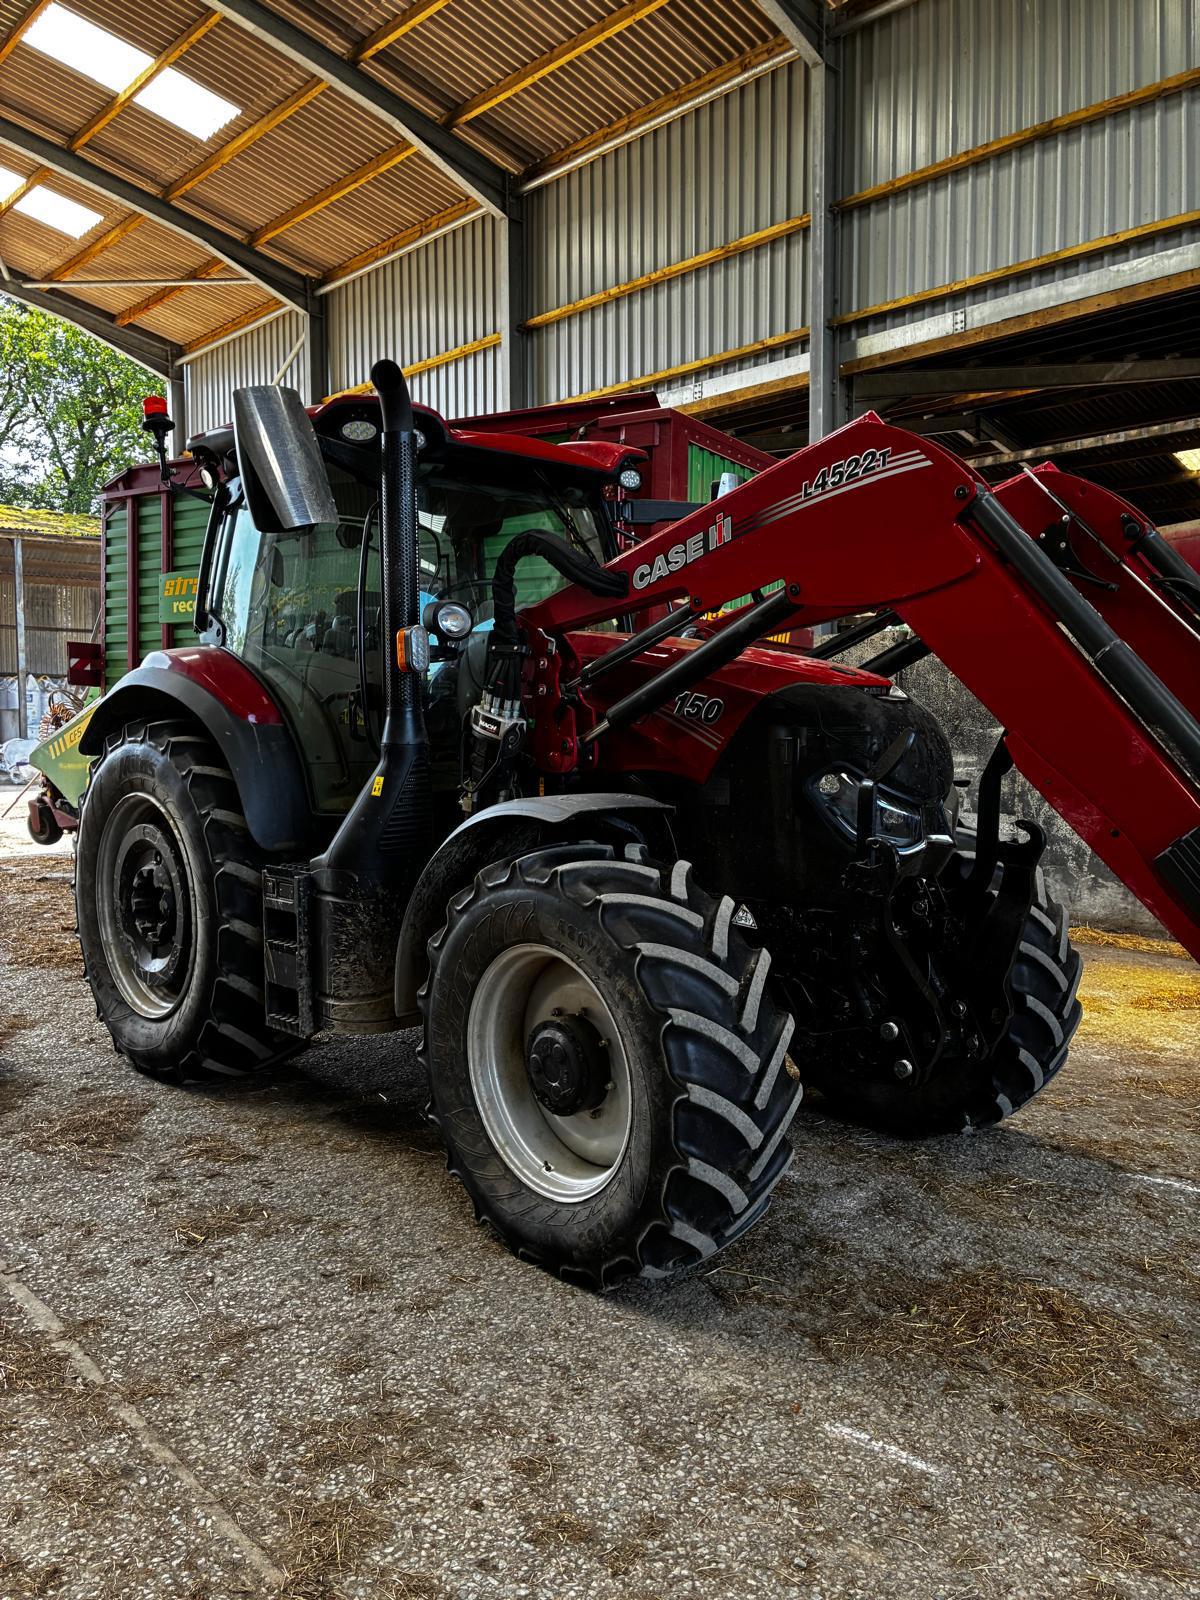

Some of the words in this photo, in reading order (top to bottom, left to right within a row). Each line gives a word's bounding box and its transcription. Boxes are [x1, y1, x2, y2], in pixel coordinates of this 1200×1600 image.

[802, 447, 892, 500] L4522T
[632, 531, 704, 590] CASE
[674, 690, 724, 725] 150
[69, 727, 82, 743] CFS
